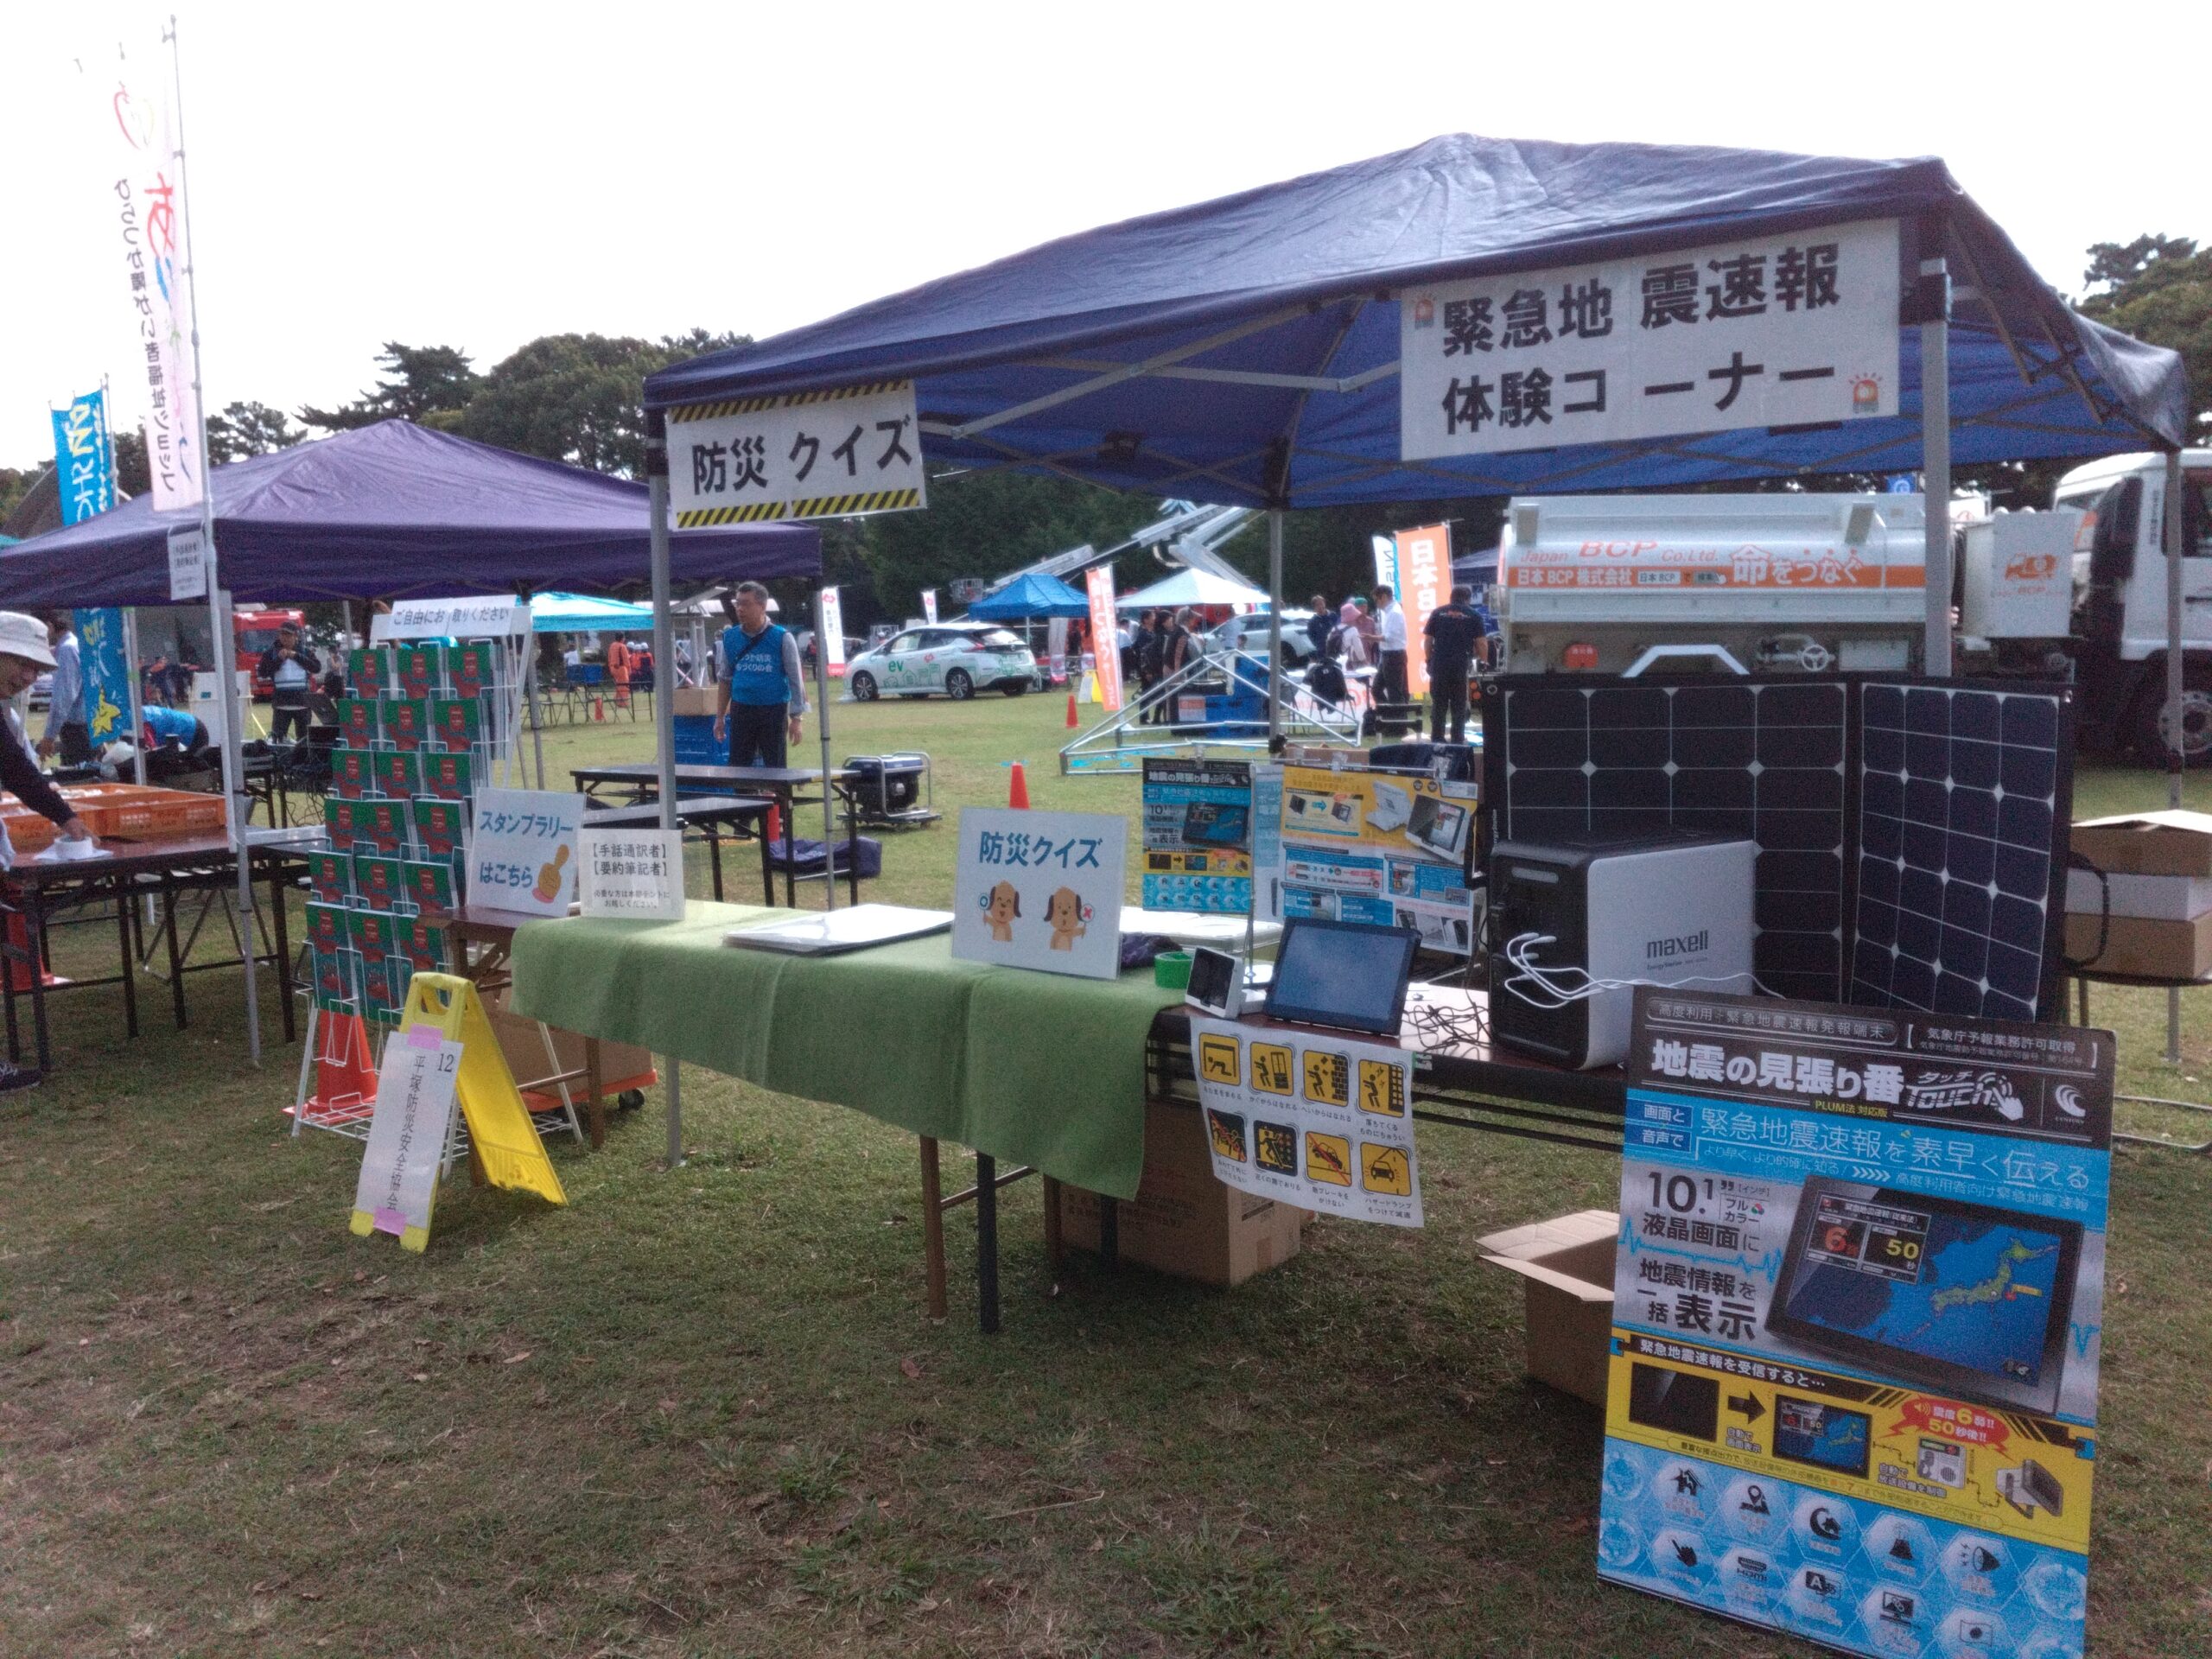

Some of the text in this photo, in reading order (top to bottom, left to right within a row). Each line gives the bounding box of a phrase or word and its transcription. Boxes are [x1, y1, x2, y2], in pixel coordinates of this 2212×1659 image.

[1442, 243, 1840, 358] 緊急地震速報
[1441, 351, 1835, 435] 体験コーナー
[1579, 539, 1659, 558] BCP
[888, 660, 905, 673] ev
[480, 811, 574, 839] スタンプラリー
[979, 830, 1103, 868] 防災クイズ
[479, 862, 533, 888] はこちら
[1647, 929, 1709, 959] maxell
[437, 1053, 455, 1072] 12
[1651, 1038, 1904, 1105] 地震の見張り番
[1917, 1070, 1974, 1084] タッチ
[1644, 1104, 1686, 1123] 画面と
[1642, 1128, 1684, 1147] 音声で
[1725, 1210, 1761, 1224] カラー
[1726, 1198, 1749, 1212] フル
[1642, 1211, 1761, 1252] 液晶画面に
[1886, 1237, 1920, 1260] 50
[1638, 1258, 1758, 1301] 地震情報を
